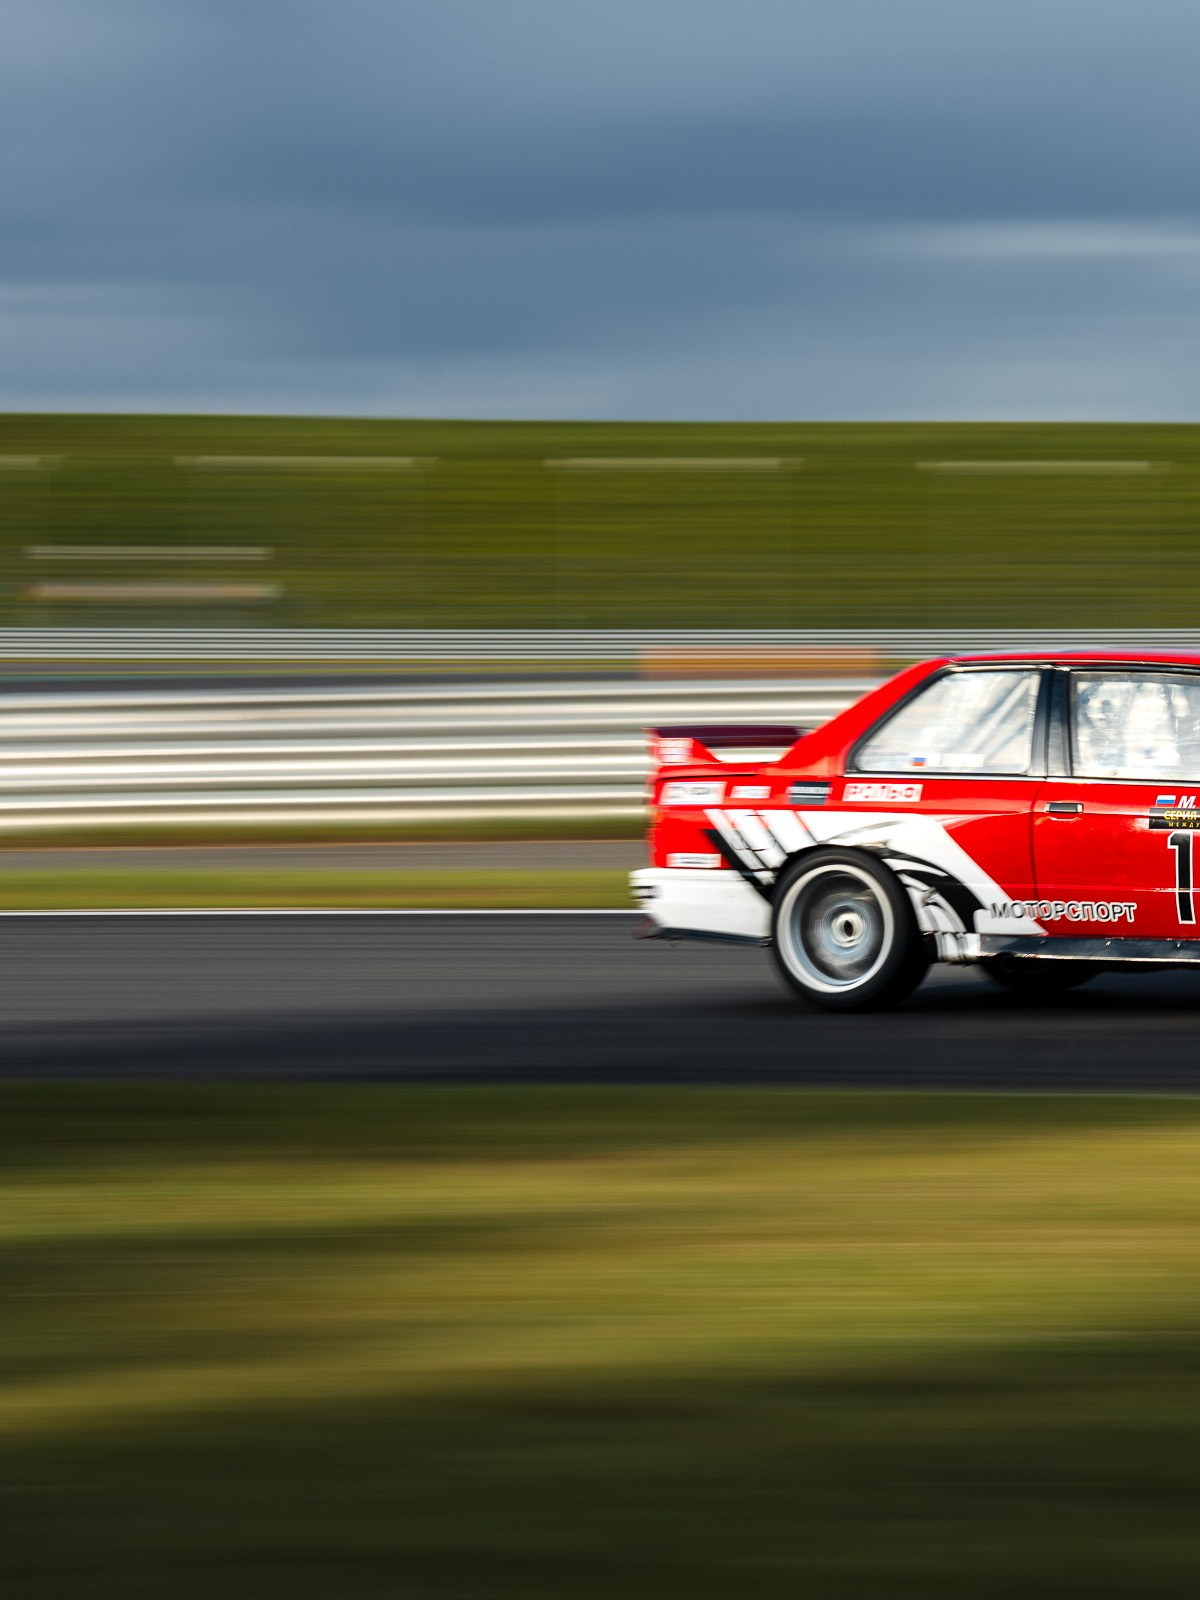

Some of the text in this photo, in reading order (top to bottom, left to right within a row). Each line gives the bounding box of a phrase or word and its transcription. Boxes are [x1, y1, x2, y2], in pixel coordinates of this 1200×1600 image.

[1177, 795, 1196, 809] М.
[1163, 810, 1196, 820] СЕРИЯ
[989, 900, 1138, 923] МОТОРСПОРТ
